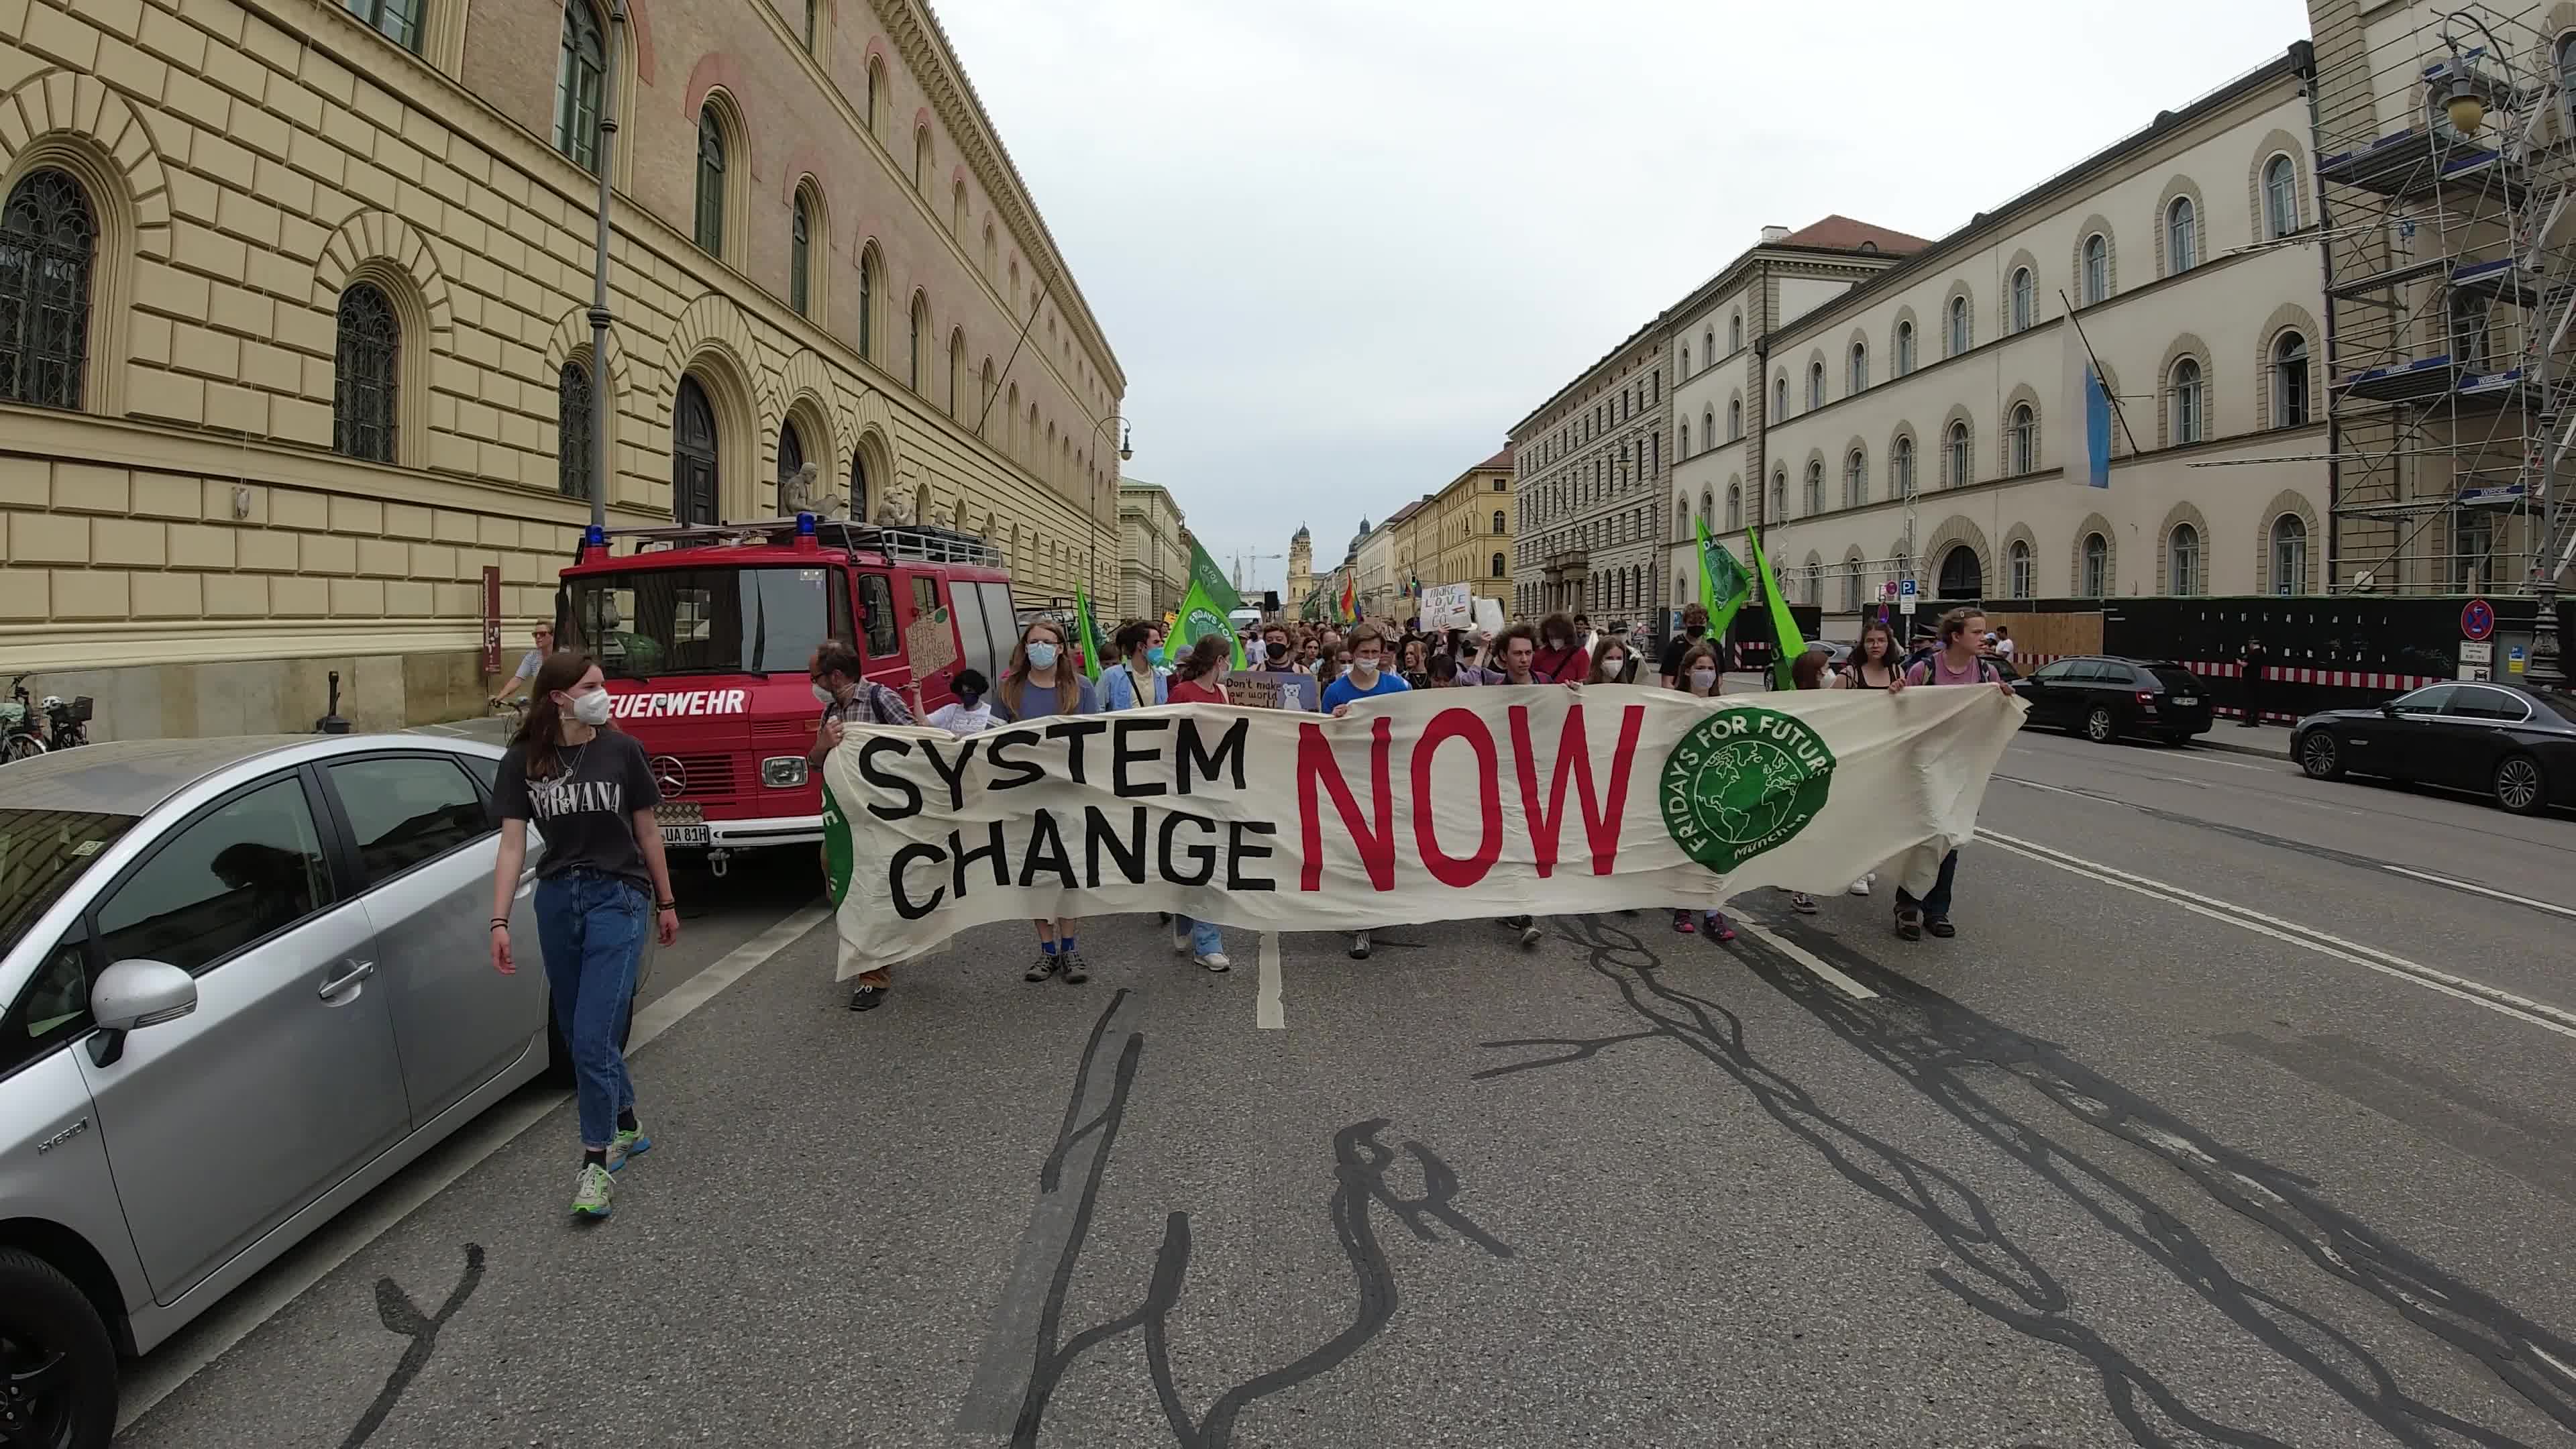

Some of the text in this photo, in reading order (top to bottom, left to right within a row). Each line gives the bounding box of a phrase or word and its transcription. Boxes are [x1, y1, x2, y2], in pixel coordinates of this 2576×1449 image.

[1426, 594, 1465, 608] LOVE
[1903, 582, 1911, 593] P
[1226, 677, 1281, 691] Don't make
[1248, 691, 1277, 700] world
[607, 690, 745, 718] EUERWEHR
[859, 718, 1248, 820] SYSTEM
[1668, 748, 1708, 853] FRIDAYS
[1697, 715, 1750, 749] FOR
[527, 781, 621, 820] NRVANA
[1297, 704, 1646, 892] NOW
[665, 828, 707, 842] UA 81H
[1734, 814, 1808, 861] Münchn
[889, 806, 1277, 920] CHANGE
